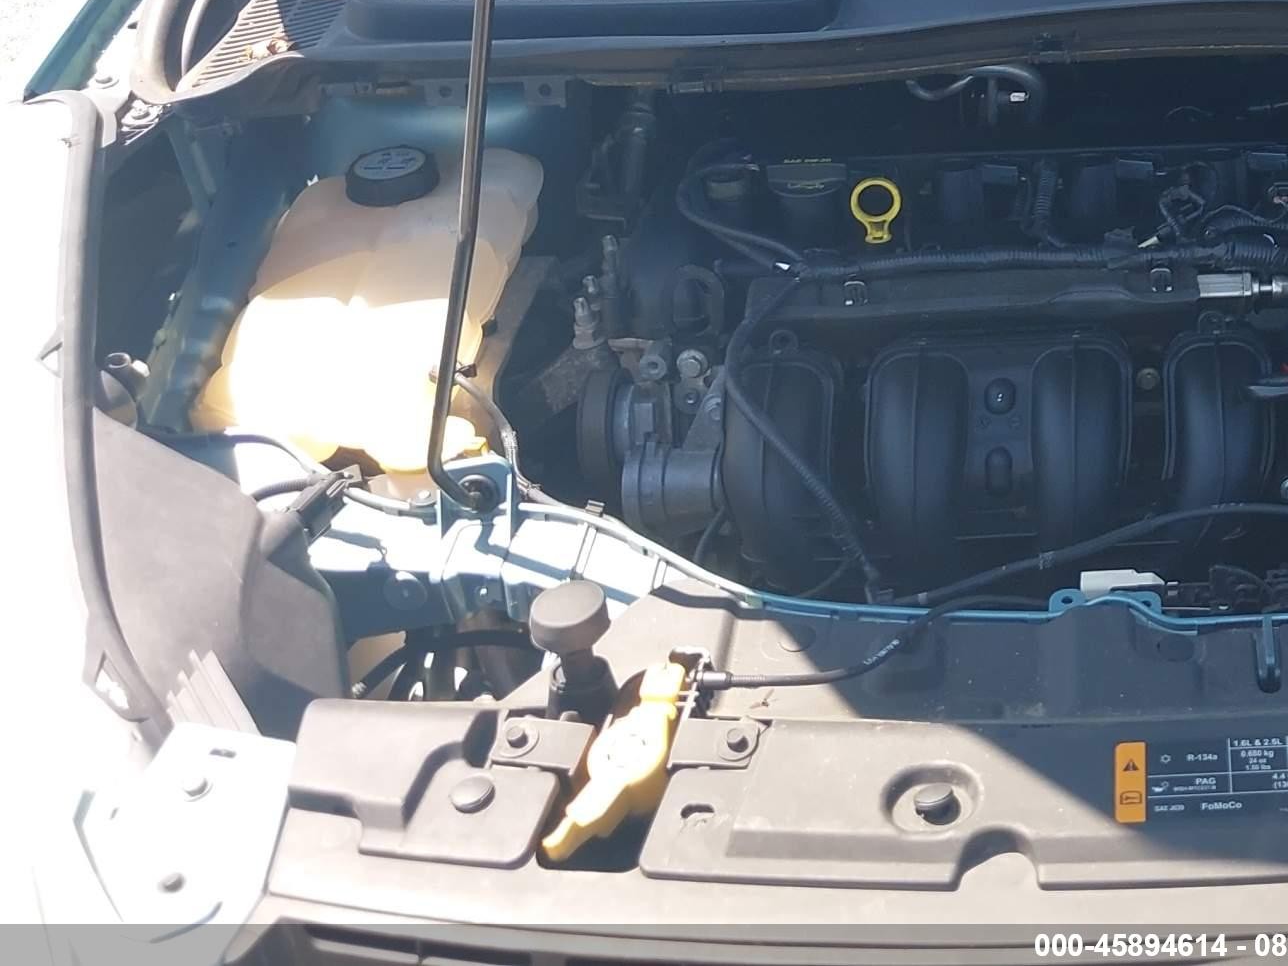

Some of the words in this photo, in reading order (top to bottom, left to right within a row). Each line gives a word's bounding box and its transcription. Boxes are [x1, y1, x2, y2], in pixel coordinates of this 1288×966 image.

[1254, 738, 1262, 746] &
[1263, 749, 1274, 758] kg
[1196, 777, 1216, 785] PAG
[1201, 801, 1242, 810] FoMoCo
